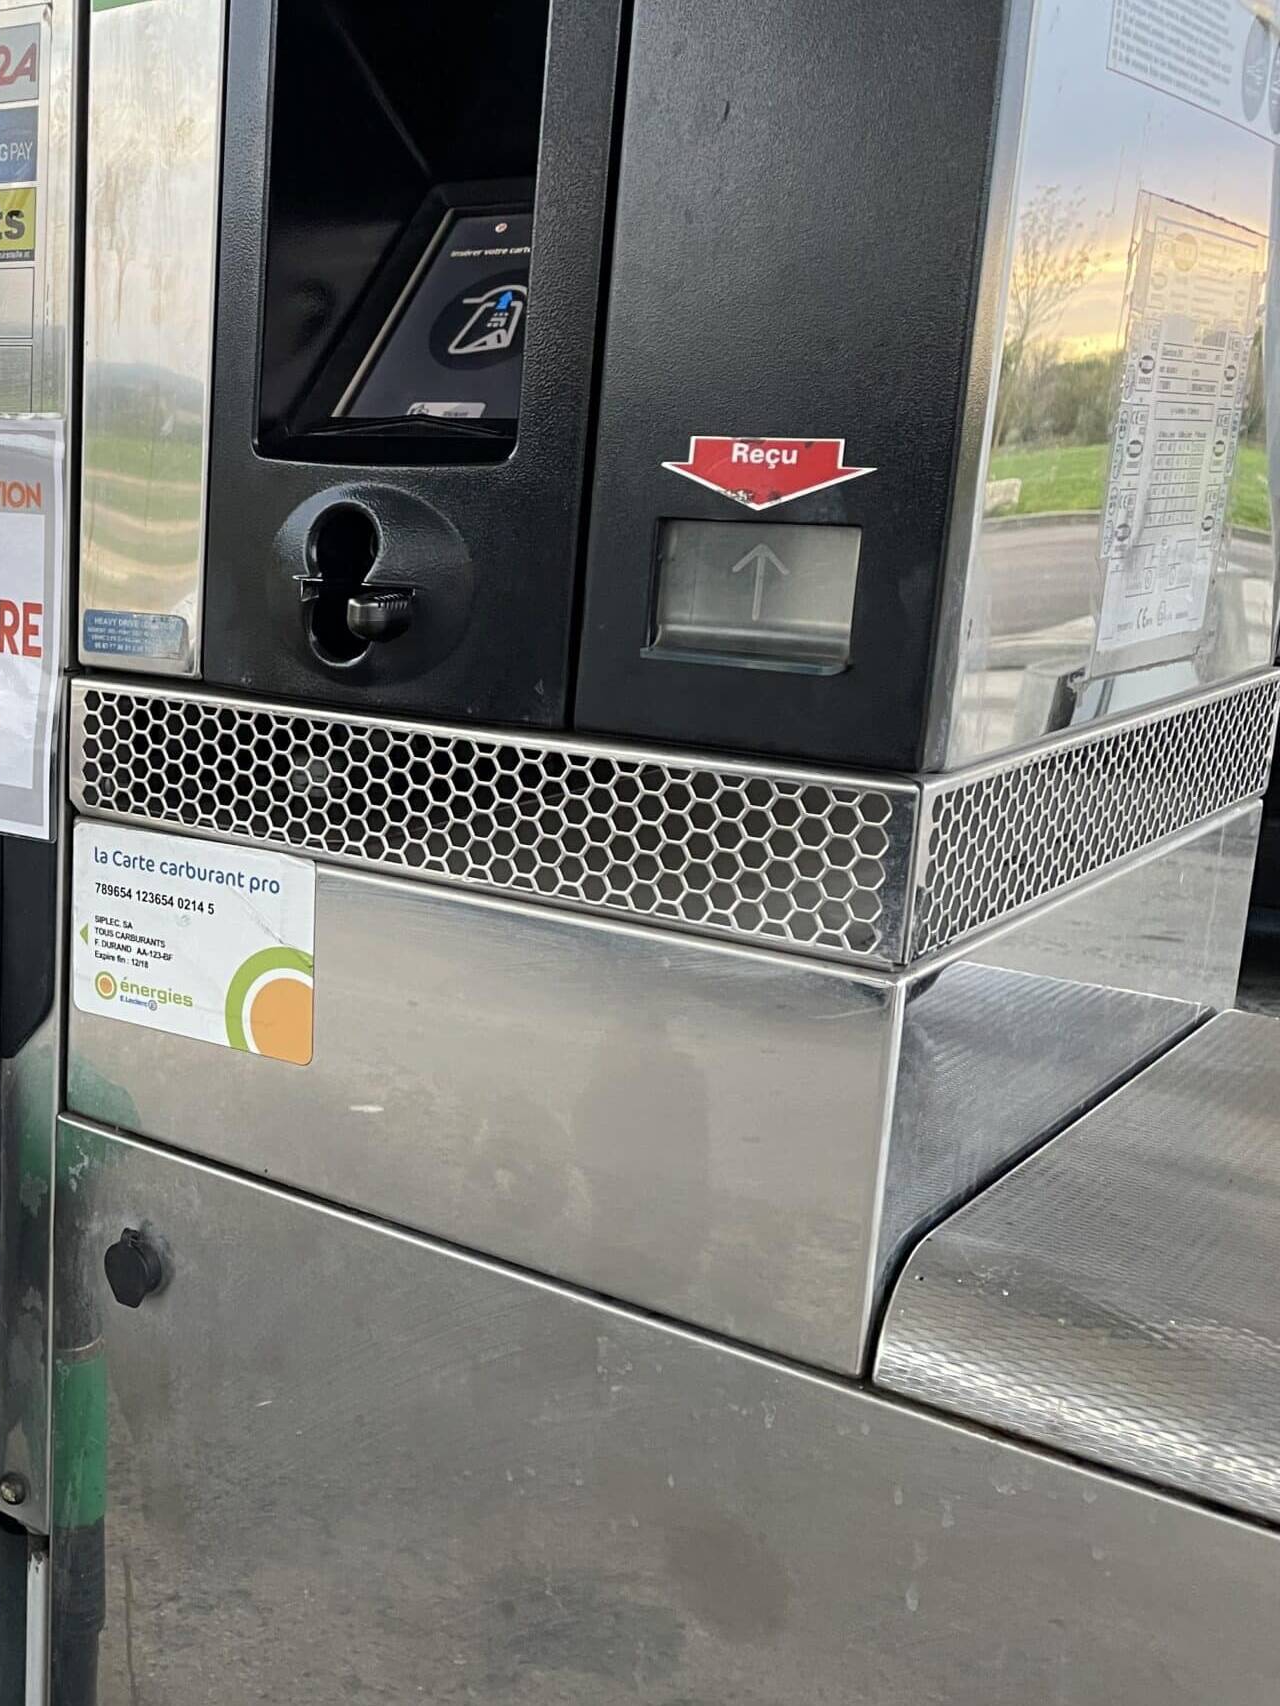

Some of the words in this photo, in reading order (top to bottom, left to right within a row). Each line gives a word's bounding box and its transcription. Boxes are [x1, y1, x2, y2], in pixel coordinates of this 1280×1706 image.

[731, 442, 798, 469] Reçu
[94, 846, 108, 864] la
[113, 851, 155, 873] Carte
[159, 861, 244, 888] carburant
[249, 876, 280, 895] pro
[95, 882, 132, 900] 789654
[135, 889, 174, 908] 123654
[177, 897, 204, 913] 0214
[207, 903, 215, 915] 5
[123, 920, 133, 929] SA
[95, 927, 114, 938] TOUS
[115, 931, 166, 948] CARBURANTS
[102, 940, 132, 953] DURAND
[95, 951, 115, 961] Expire
[117, 953, 126, 963] fin
[132, 959, 149, 969] 12/18
[120, 977, 193, 1007] énergies
